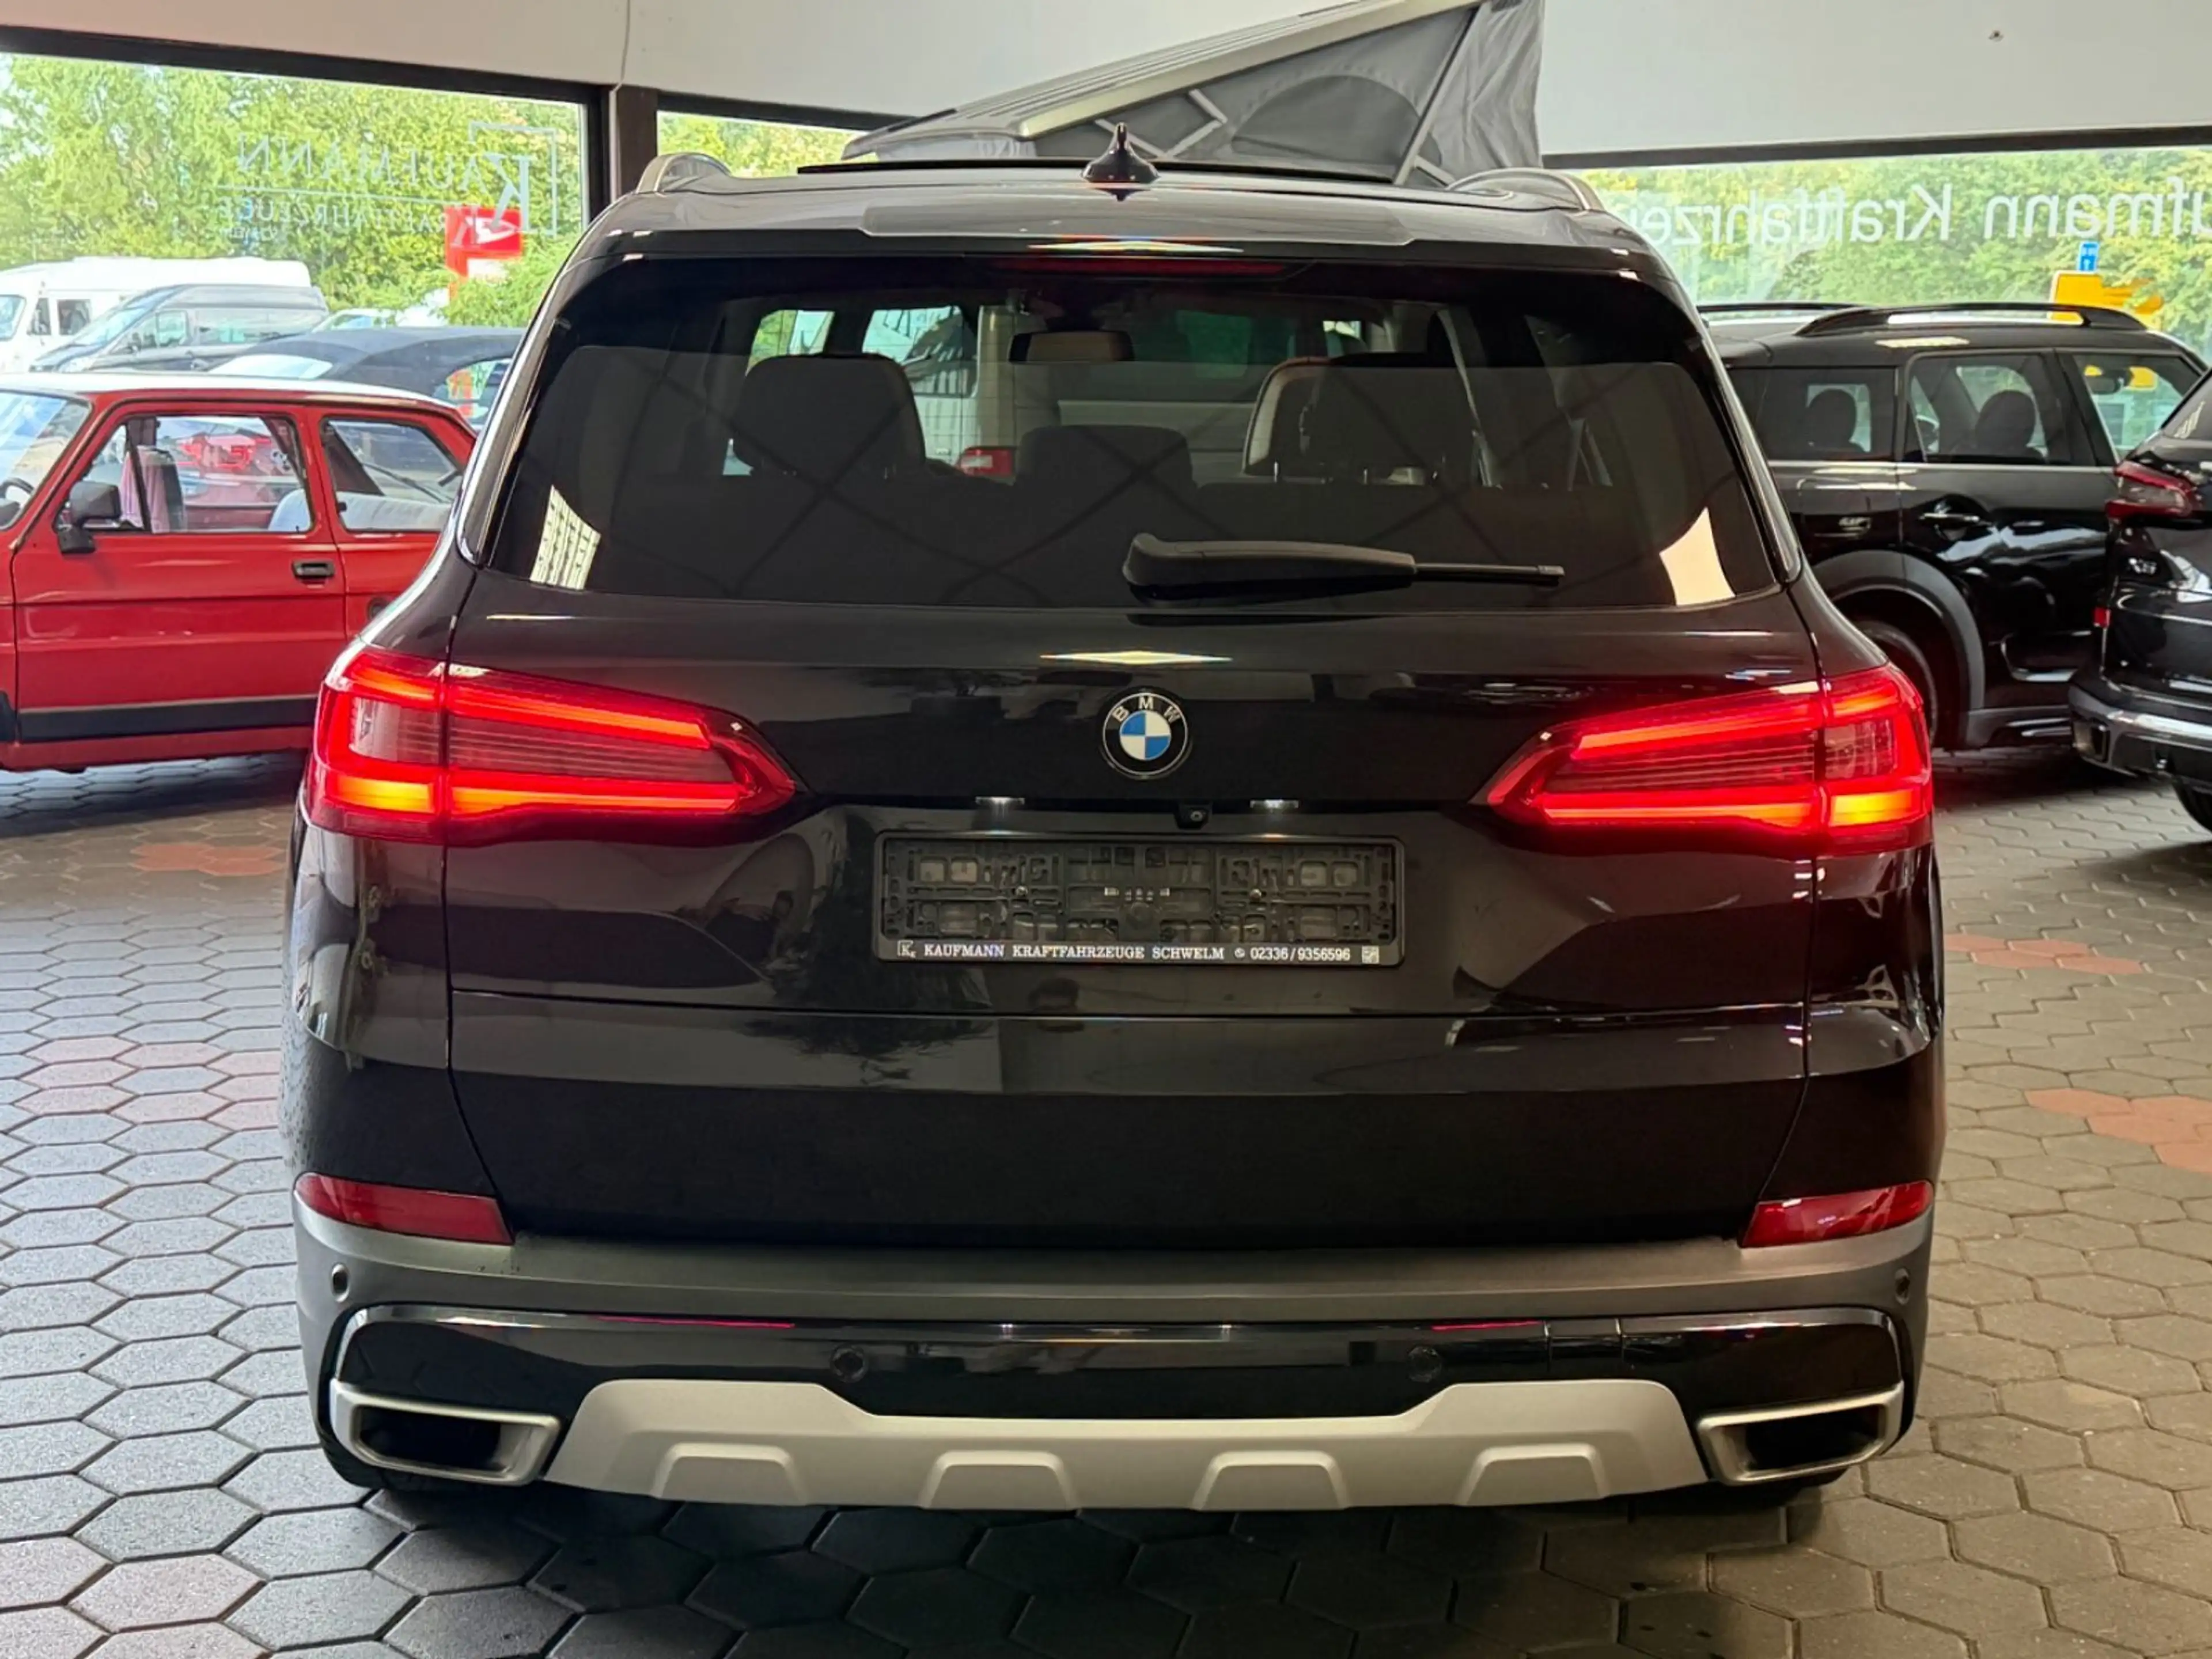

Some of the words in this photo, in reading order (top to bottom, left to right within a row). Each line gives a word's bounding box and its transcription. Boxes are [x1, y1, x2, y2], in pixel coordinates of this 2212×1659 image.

[1112, 696, 1181, 724] BMW
[924, 944, 1005, 957] KAUFMANN
[1013, 945, 1145, 959] KRAFTFAHRZEUGE
[1152, 946, 1225, 960] SCHWELM
